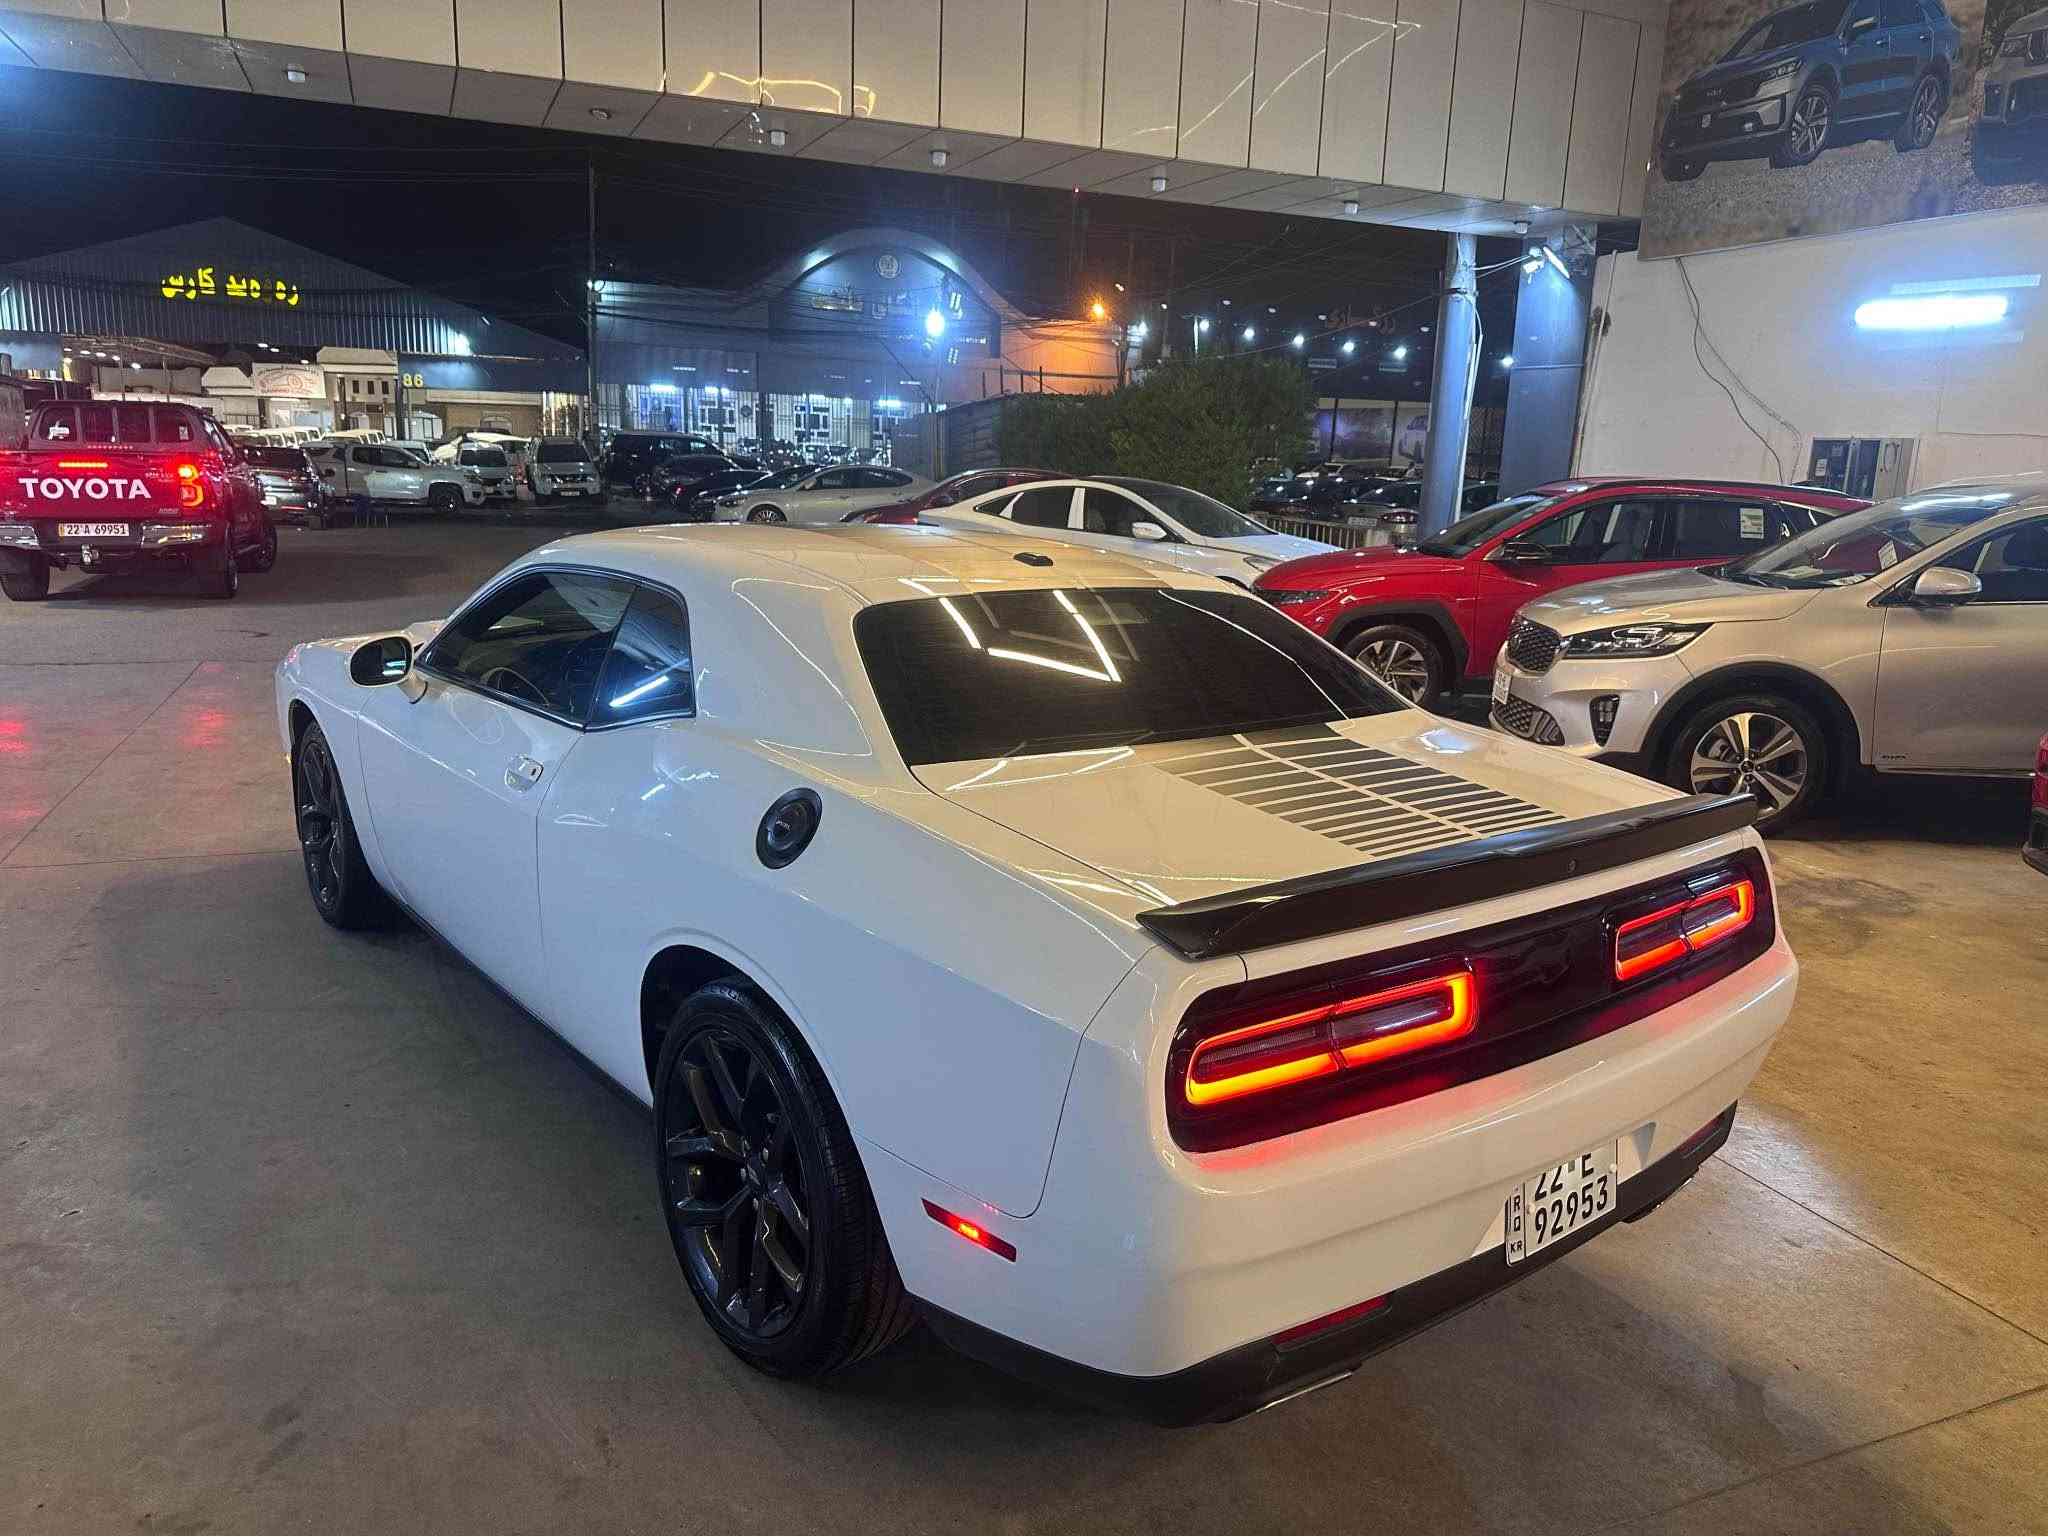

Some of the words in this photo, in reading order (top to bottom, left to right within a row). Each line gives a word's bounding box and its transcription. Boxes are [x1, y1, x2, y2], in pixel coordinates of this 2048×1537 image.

[18, 477, 152, 500] TOYOTA
[66, 524, 80, 535] 22
[94, 524, 127, 535] 69951
[1535, 1175, 1609, 1245] 92953
[1510, 1241, 1523, 1253] KR
